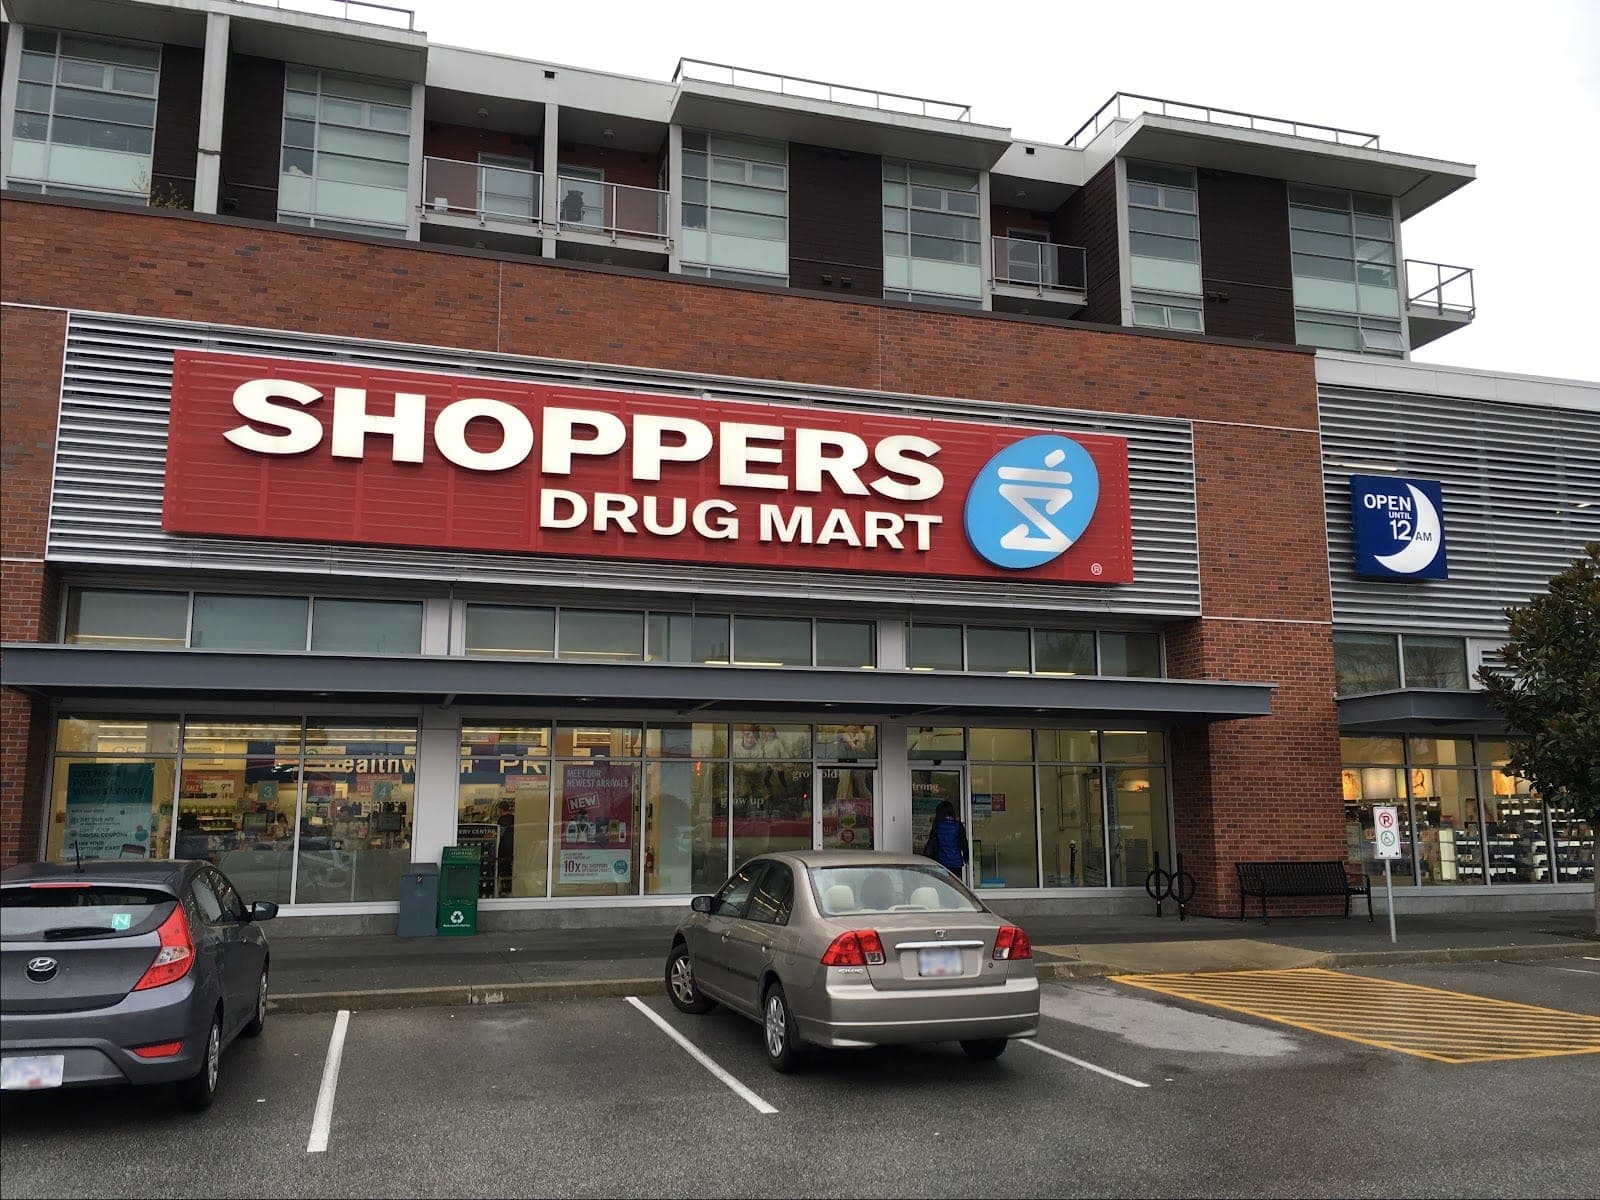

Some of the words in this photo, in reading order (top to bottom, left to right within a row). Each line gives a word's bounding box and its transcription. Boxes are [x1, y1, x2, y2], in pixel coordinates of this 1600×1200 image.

[222, 378, 944, 500] SHOPPERS
[1363, 493, 1411, 512] OPEN
[539, 488, 739, 540] DRUG
[759, 503, 943, 551] MART
[1388, 511, 1412, 520] UNTIL
[1389, 518, 1412, 541] 12
[1415, 531, 1433, 542] AM
[791, 770, 811, 782] gro
[911, 781, 940, 794] trong
[719, 796, 747, 809] gow
[750, 796, 765, 808] up
[564, 859, 581, 873] 10x
